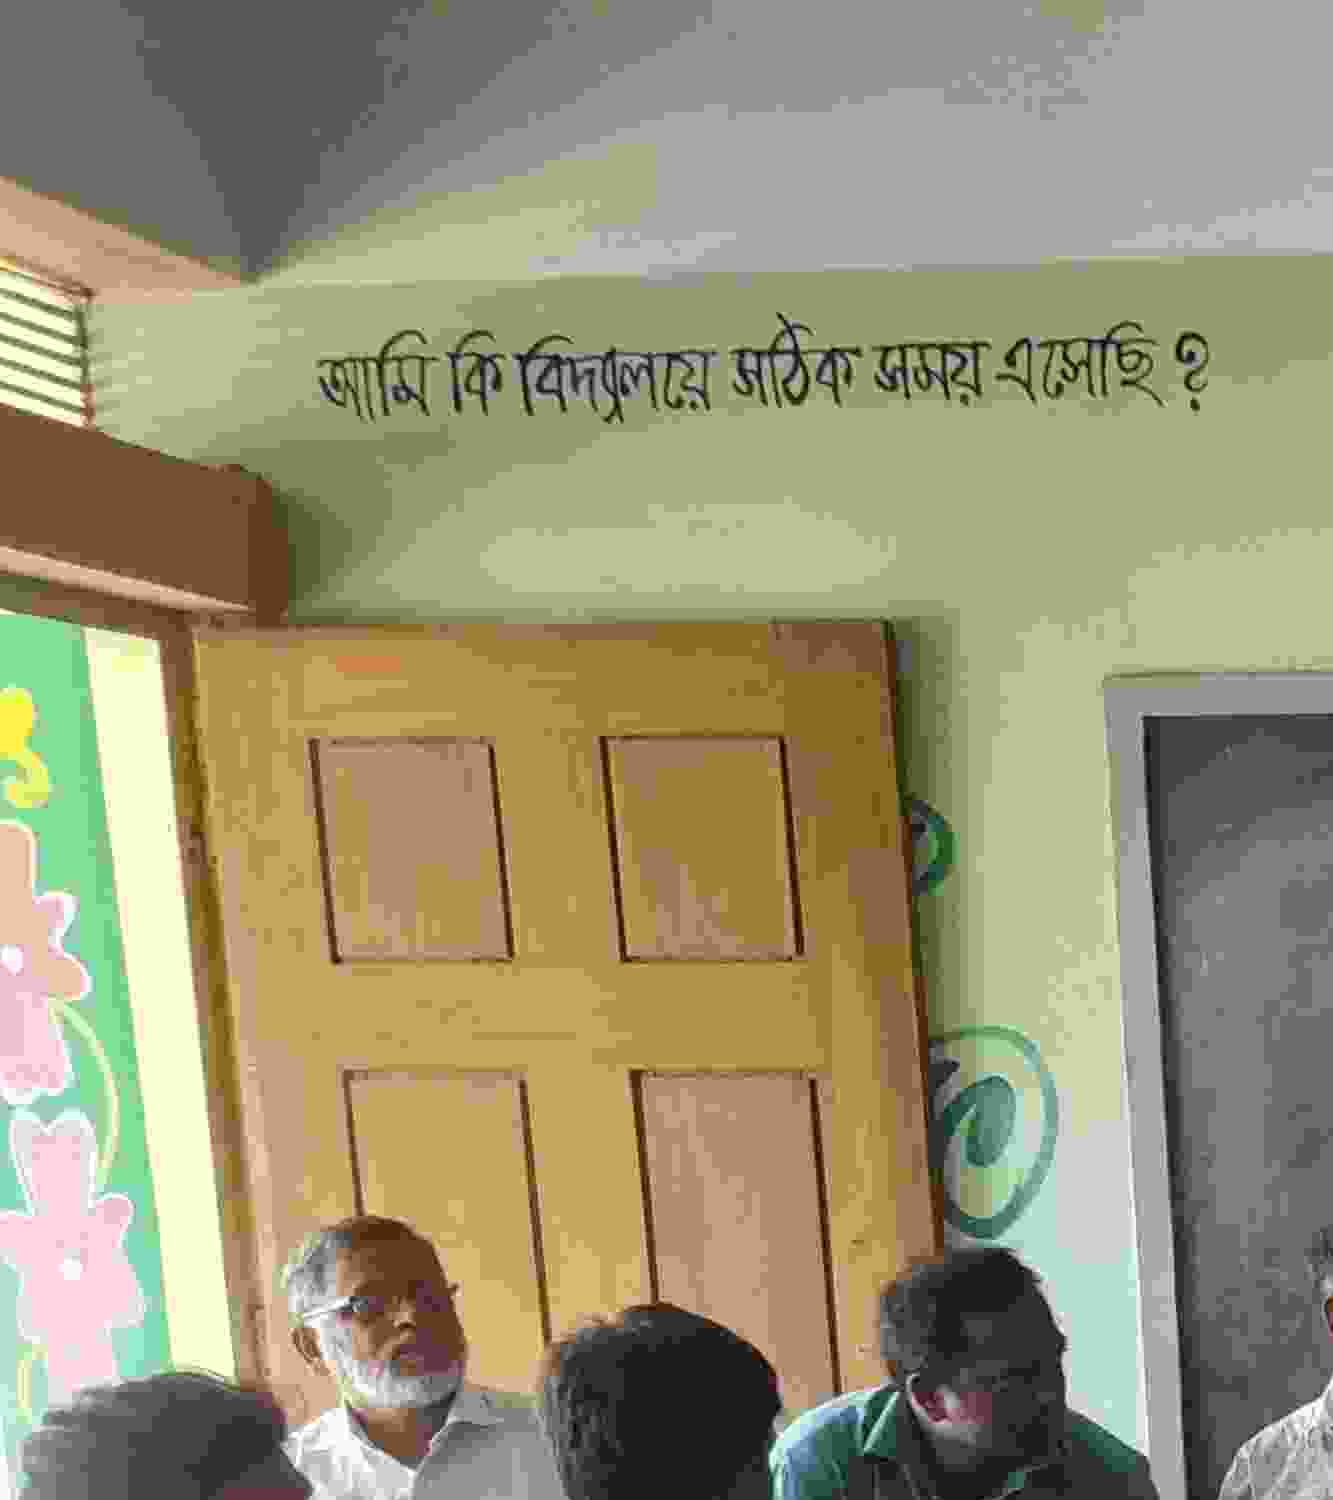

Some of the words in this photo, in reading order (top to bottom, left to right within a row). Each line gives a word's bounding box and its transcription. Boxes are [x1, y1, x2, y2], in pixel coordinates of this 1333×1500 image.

[315, 329, 440, 424] আমি
[446, 329, 506, 416] কি
[728, 311, 864, 408] সঠিক
[872, 340, 992, 406] সময়
[994, 319, 1168, 407] এসেছি
[1175, 330, 1209, 412] ?
